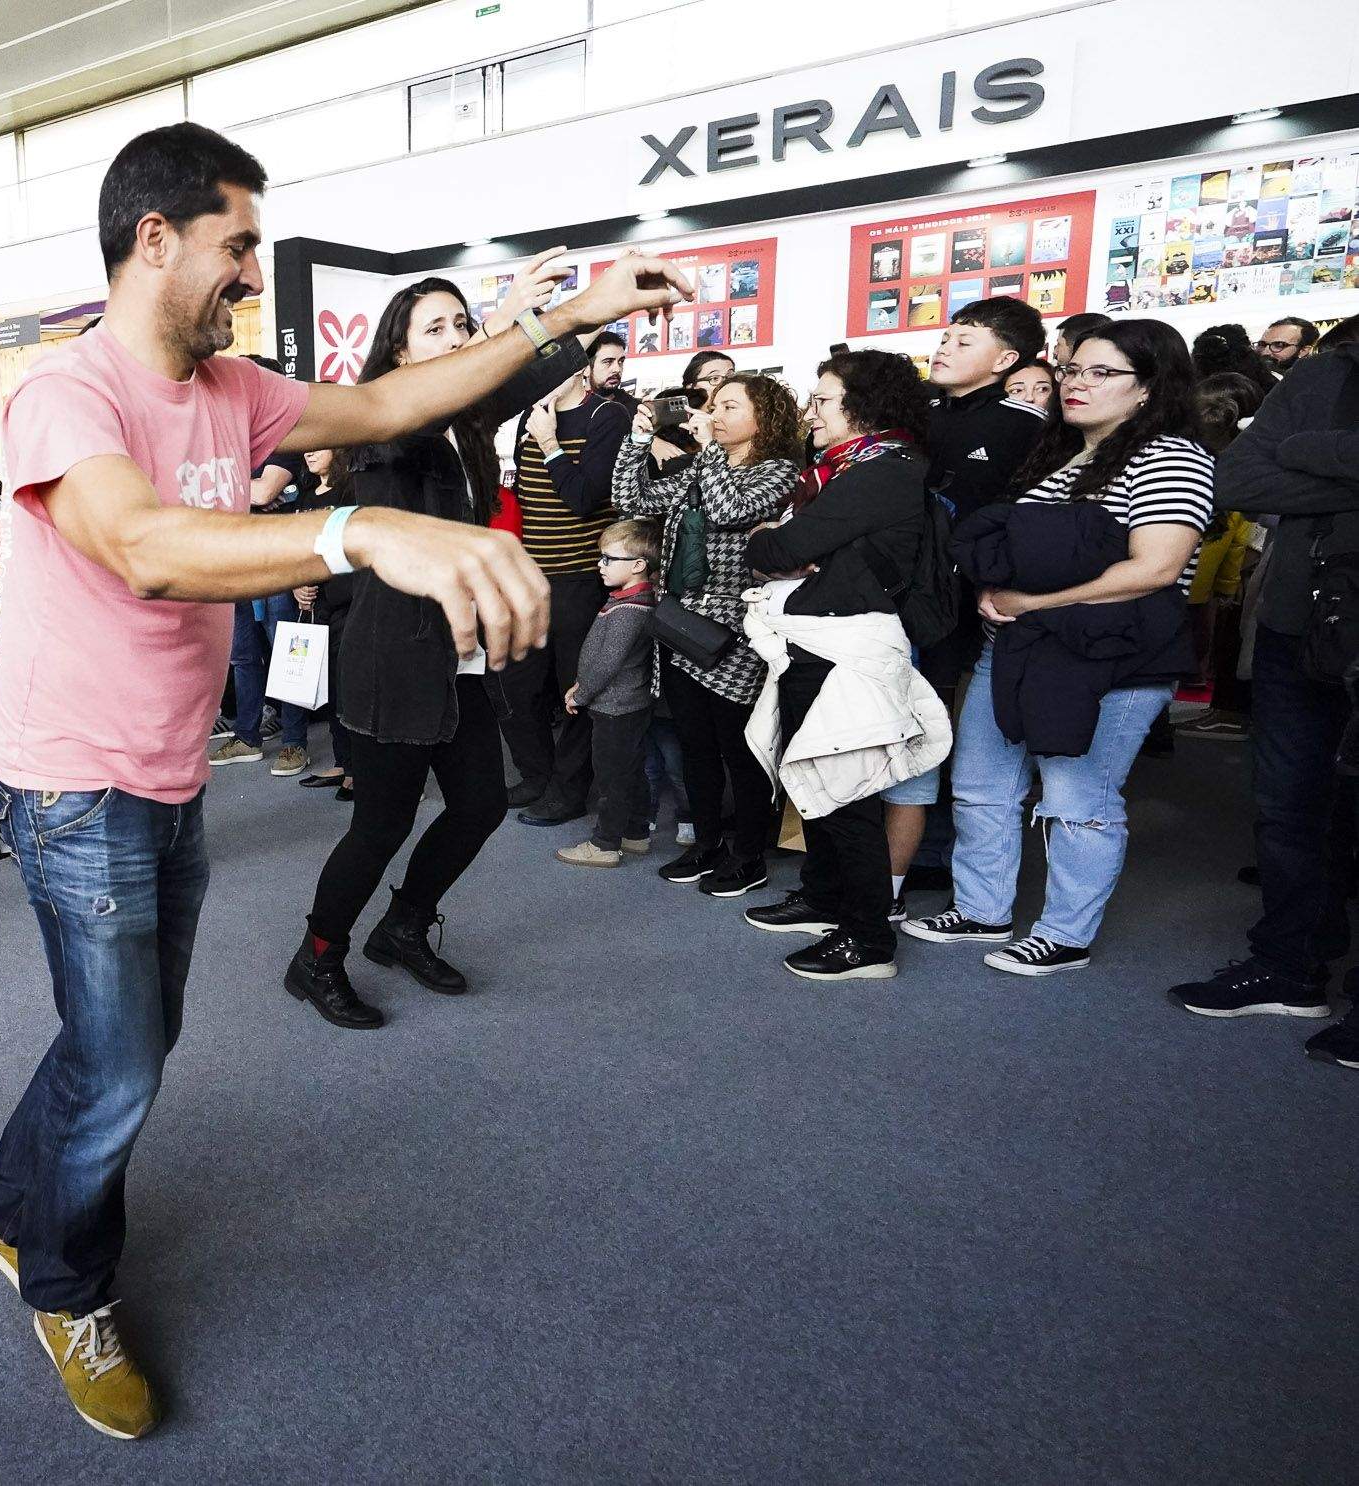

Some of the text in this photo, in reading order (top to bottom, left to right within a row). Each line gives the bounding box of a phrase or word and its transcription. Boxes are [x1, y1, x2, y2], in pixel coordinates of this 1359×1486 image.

[638, 57, 1045, 185] XERAIS
[869, 229, 882, 237] OS
[912, 217, 963, 231] VENDIDOS
[1114, 226, 1134, 236] XXI
[281, 328, 297, 380] is.gal
